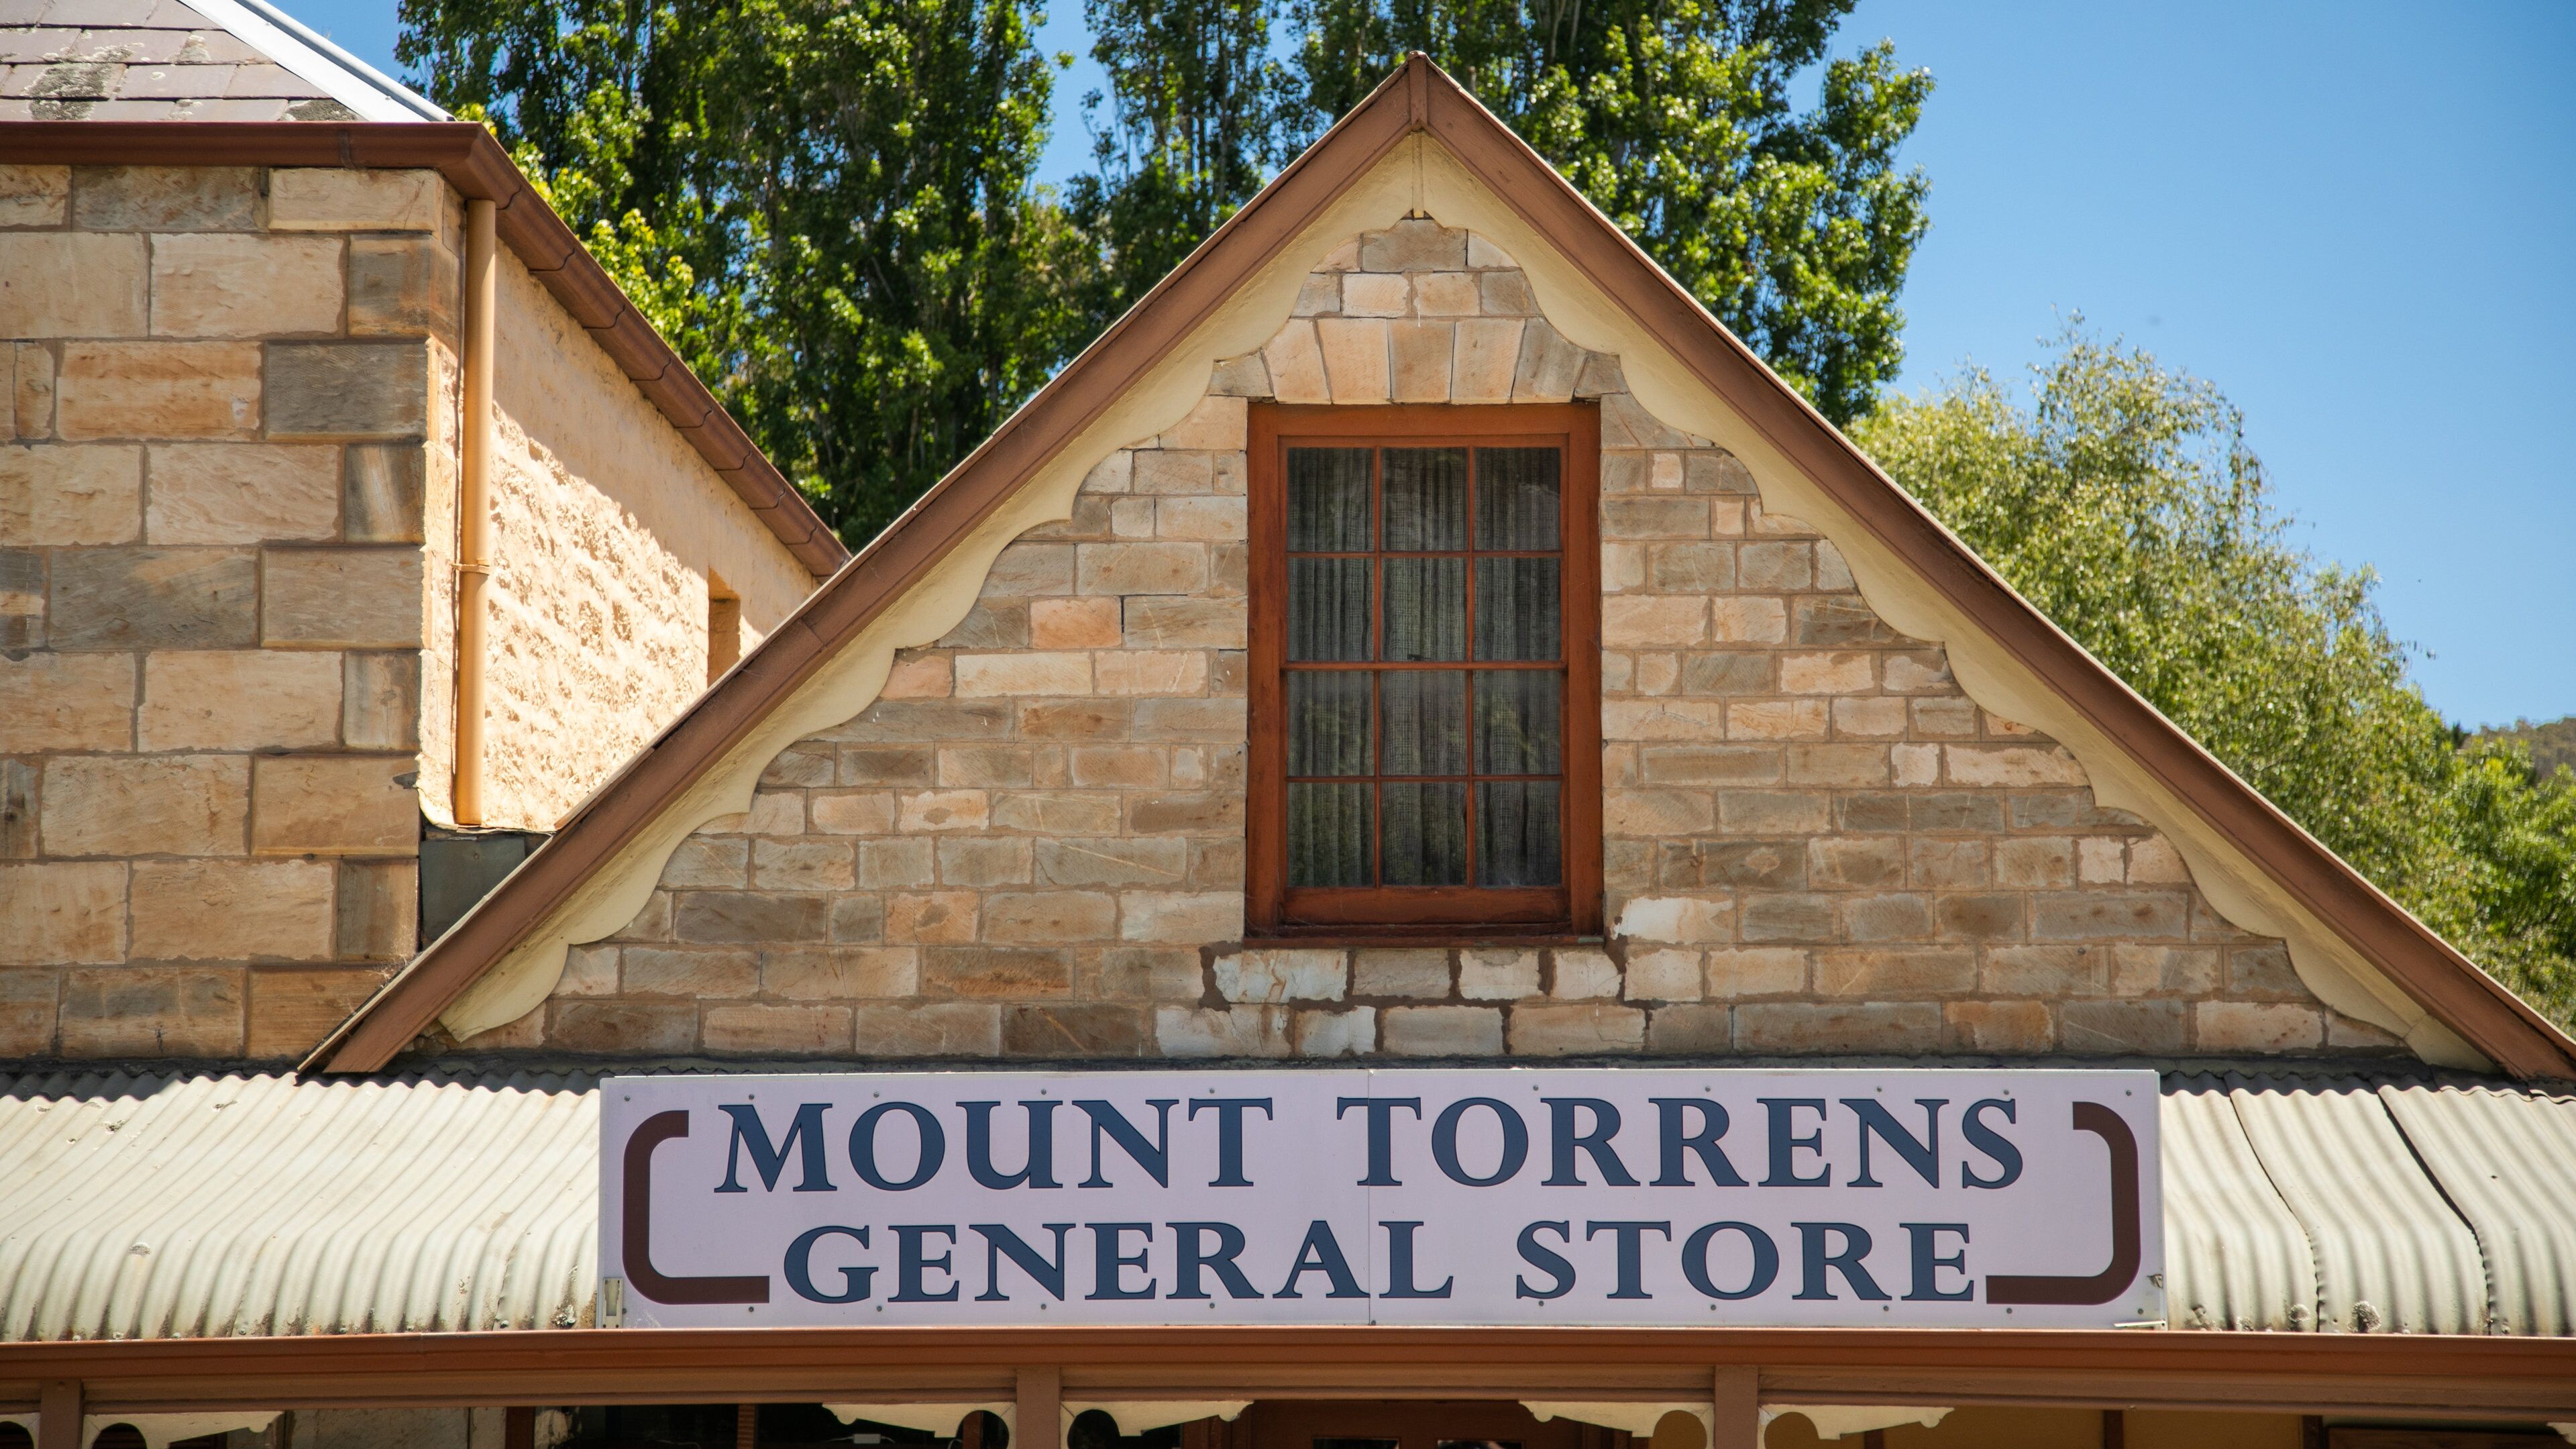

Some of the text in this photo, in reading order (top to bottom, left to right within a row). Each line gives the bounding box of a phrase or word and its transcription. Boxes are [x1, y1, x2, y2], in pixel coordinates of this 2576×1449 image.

[714, 1096, 2024, 1193] MOUNT TORRENS
[783, 1220, 1975, 1304] GENERAL STORE
